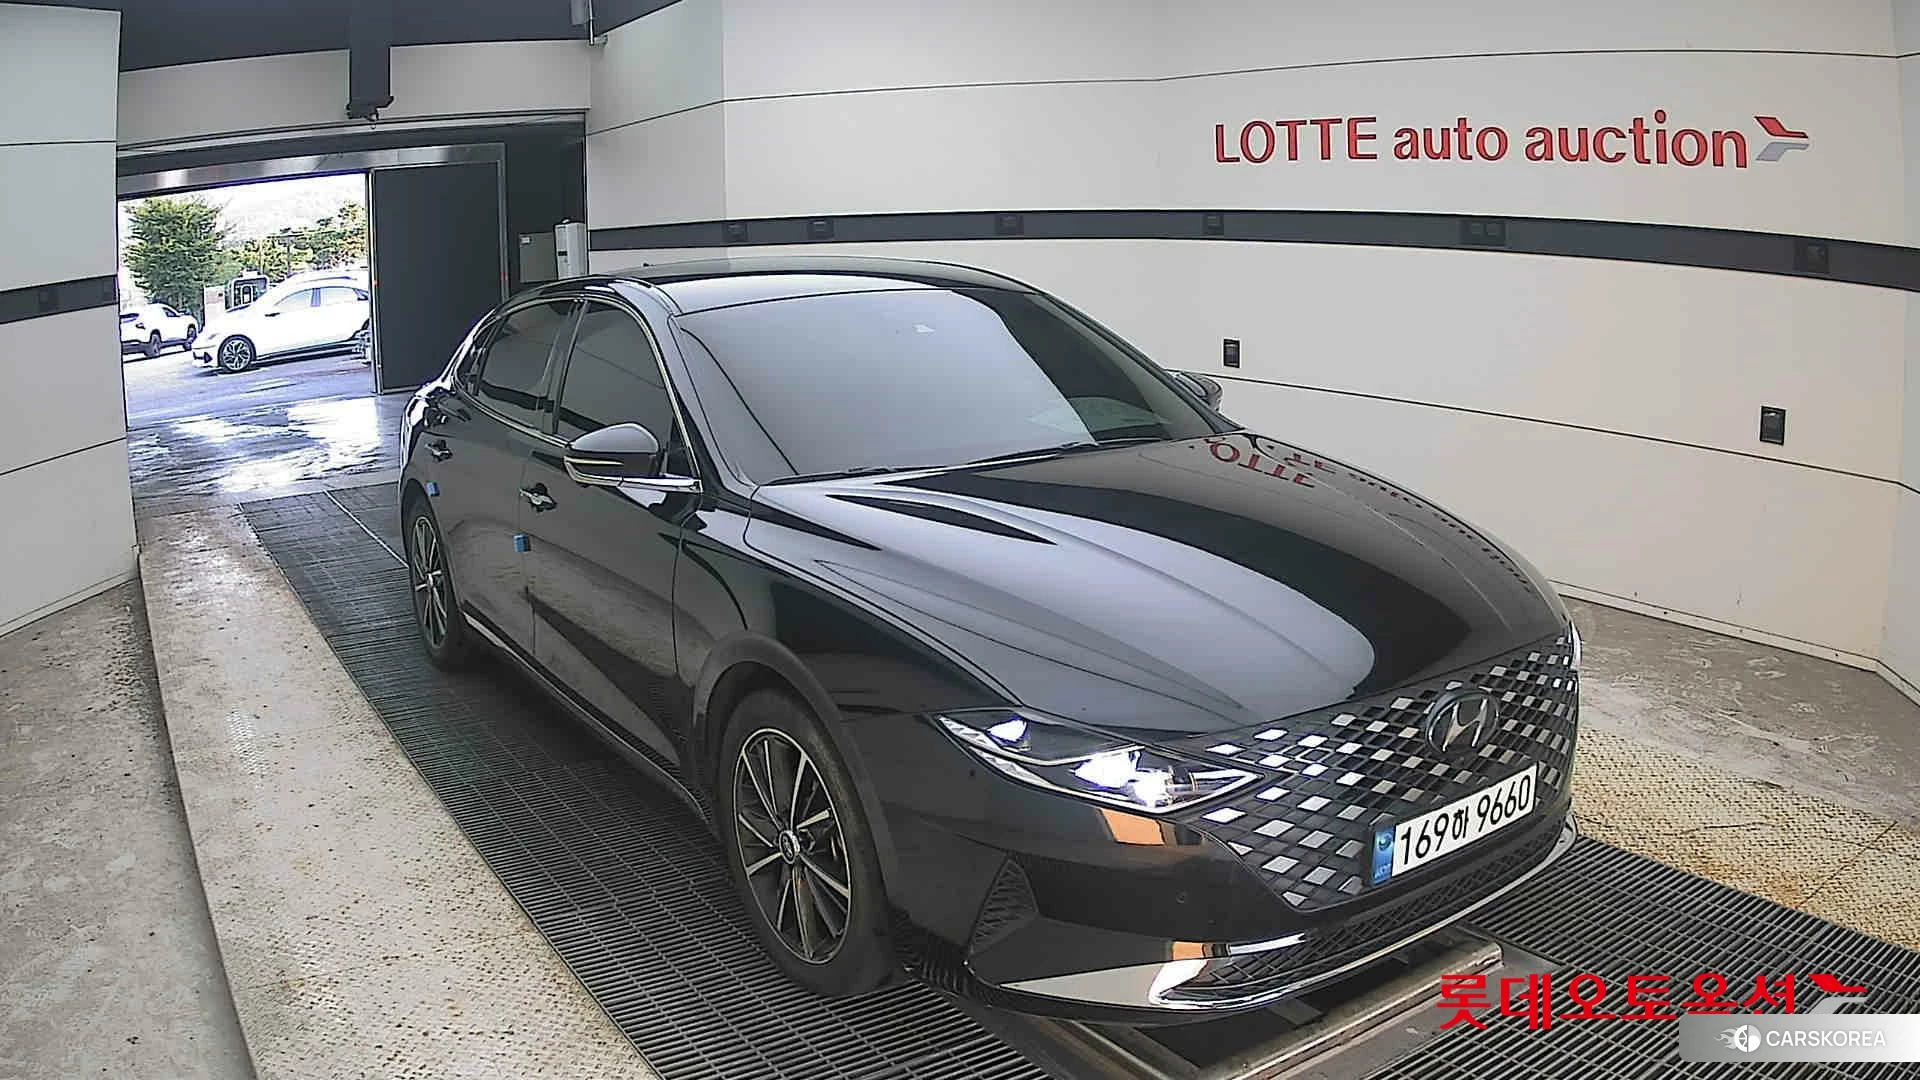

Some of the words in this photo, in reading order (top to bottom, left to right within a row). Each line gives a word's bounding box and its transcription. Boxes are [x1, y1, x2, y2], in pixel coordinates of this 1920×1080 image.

[1215, 116, 1378, 163] LOTTE
[1393, 116, 1509, 162] auto
[1524, 109, 1748, 169] auction
[1400, 805, 1470, 865] 169하
[1477, 774, 1531, 832] 9660
